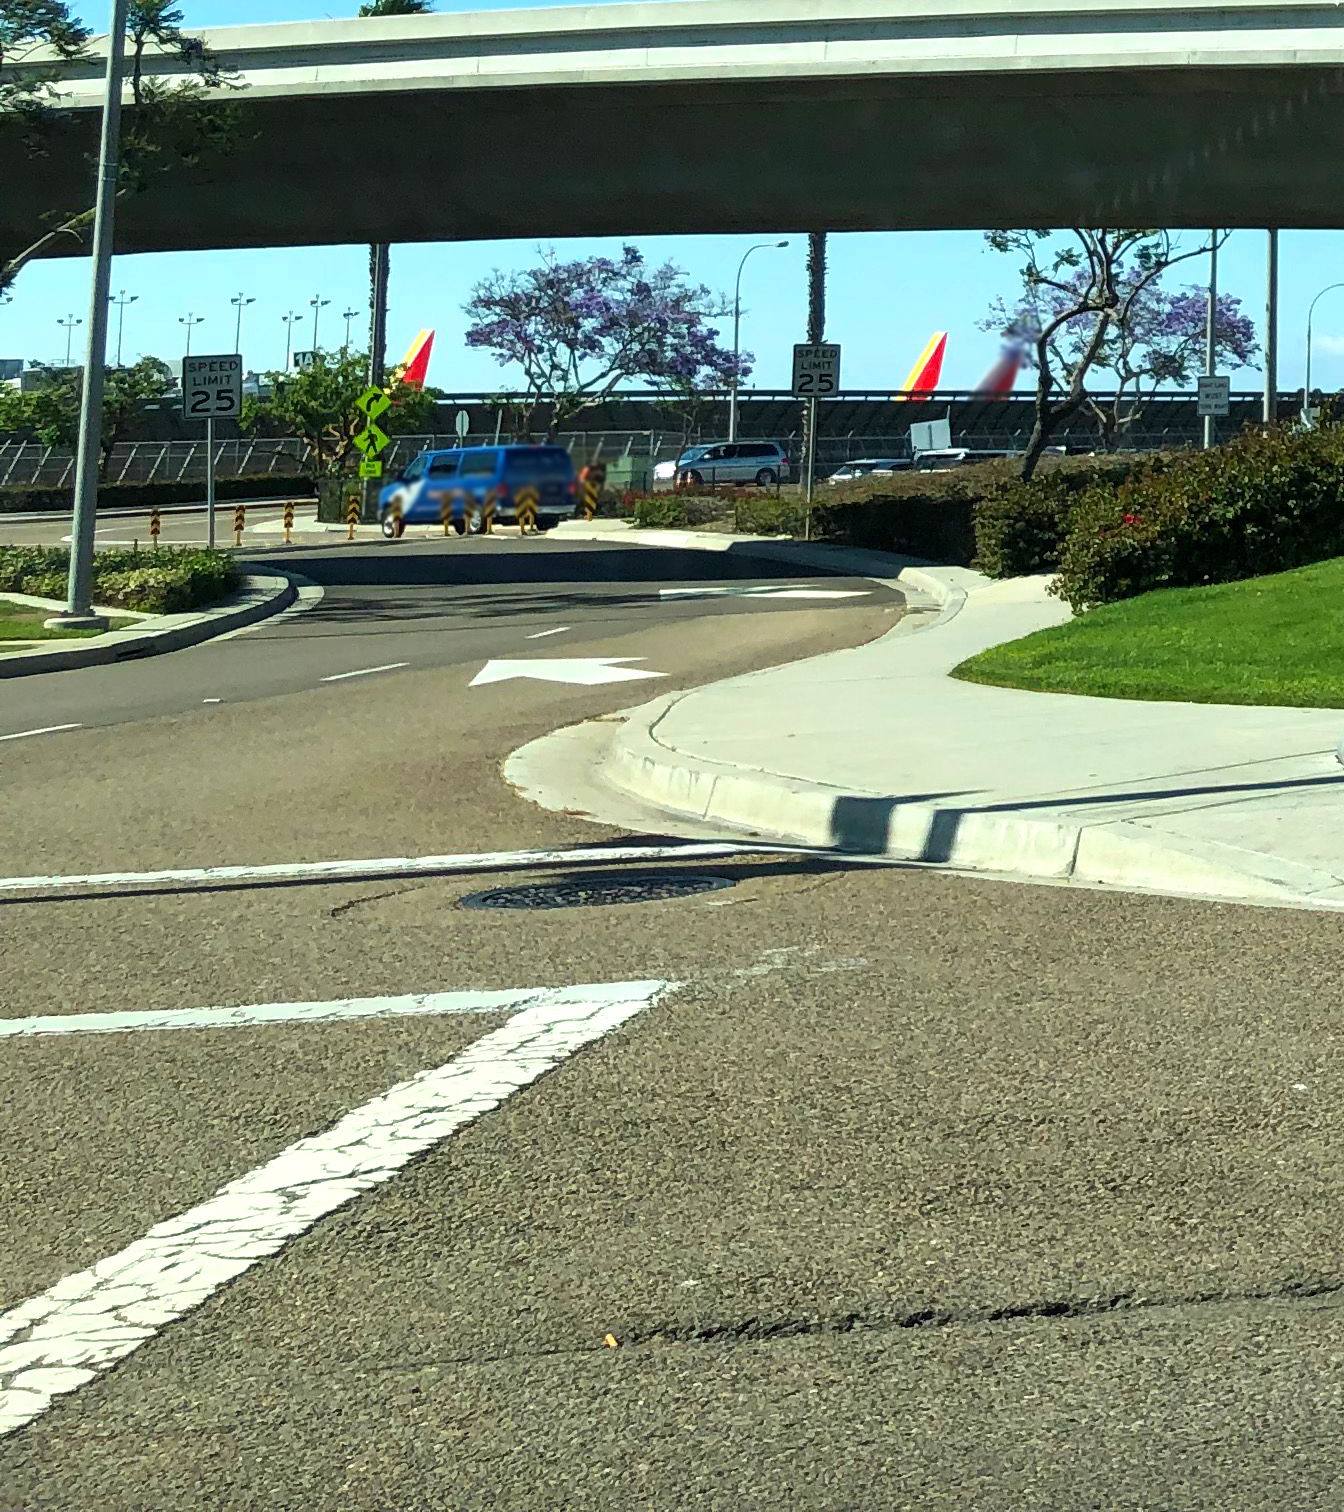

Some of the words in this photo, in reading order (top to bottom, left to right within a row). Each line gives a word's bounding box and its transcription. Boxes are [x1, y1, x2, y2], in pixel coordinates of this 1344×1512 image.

[797, 349, 837, 358] SPEED
[188, 360, 238, 372] SPEED
[801, 361, 832, 370] LIMIT
[193, 374, 232, 386] LIMIT
[798, 374, 833, 392] 25
[191, 389, 235, 413] 25
